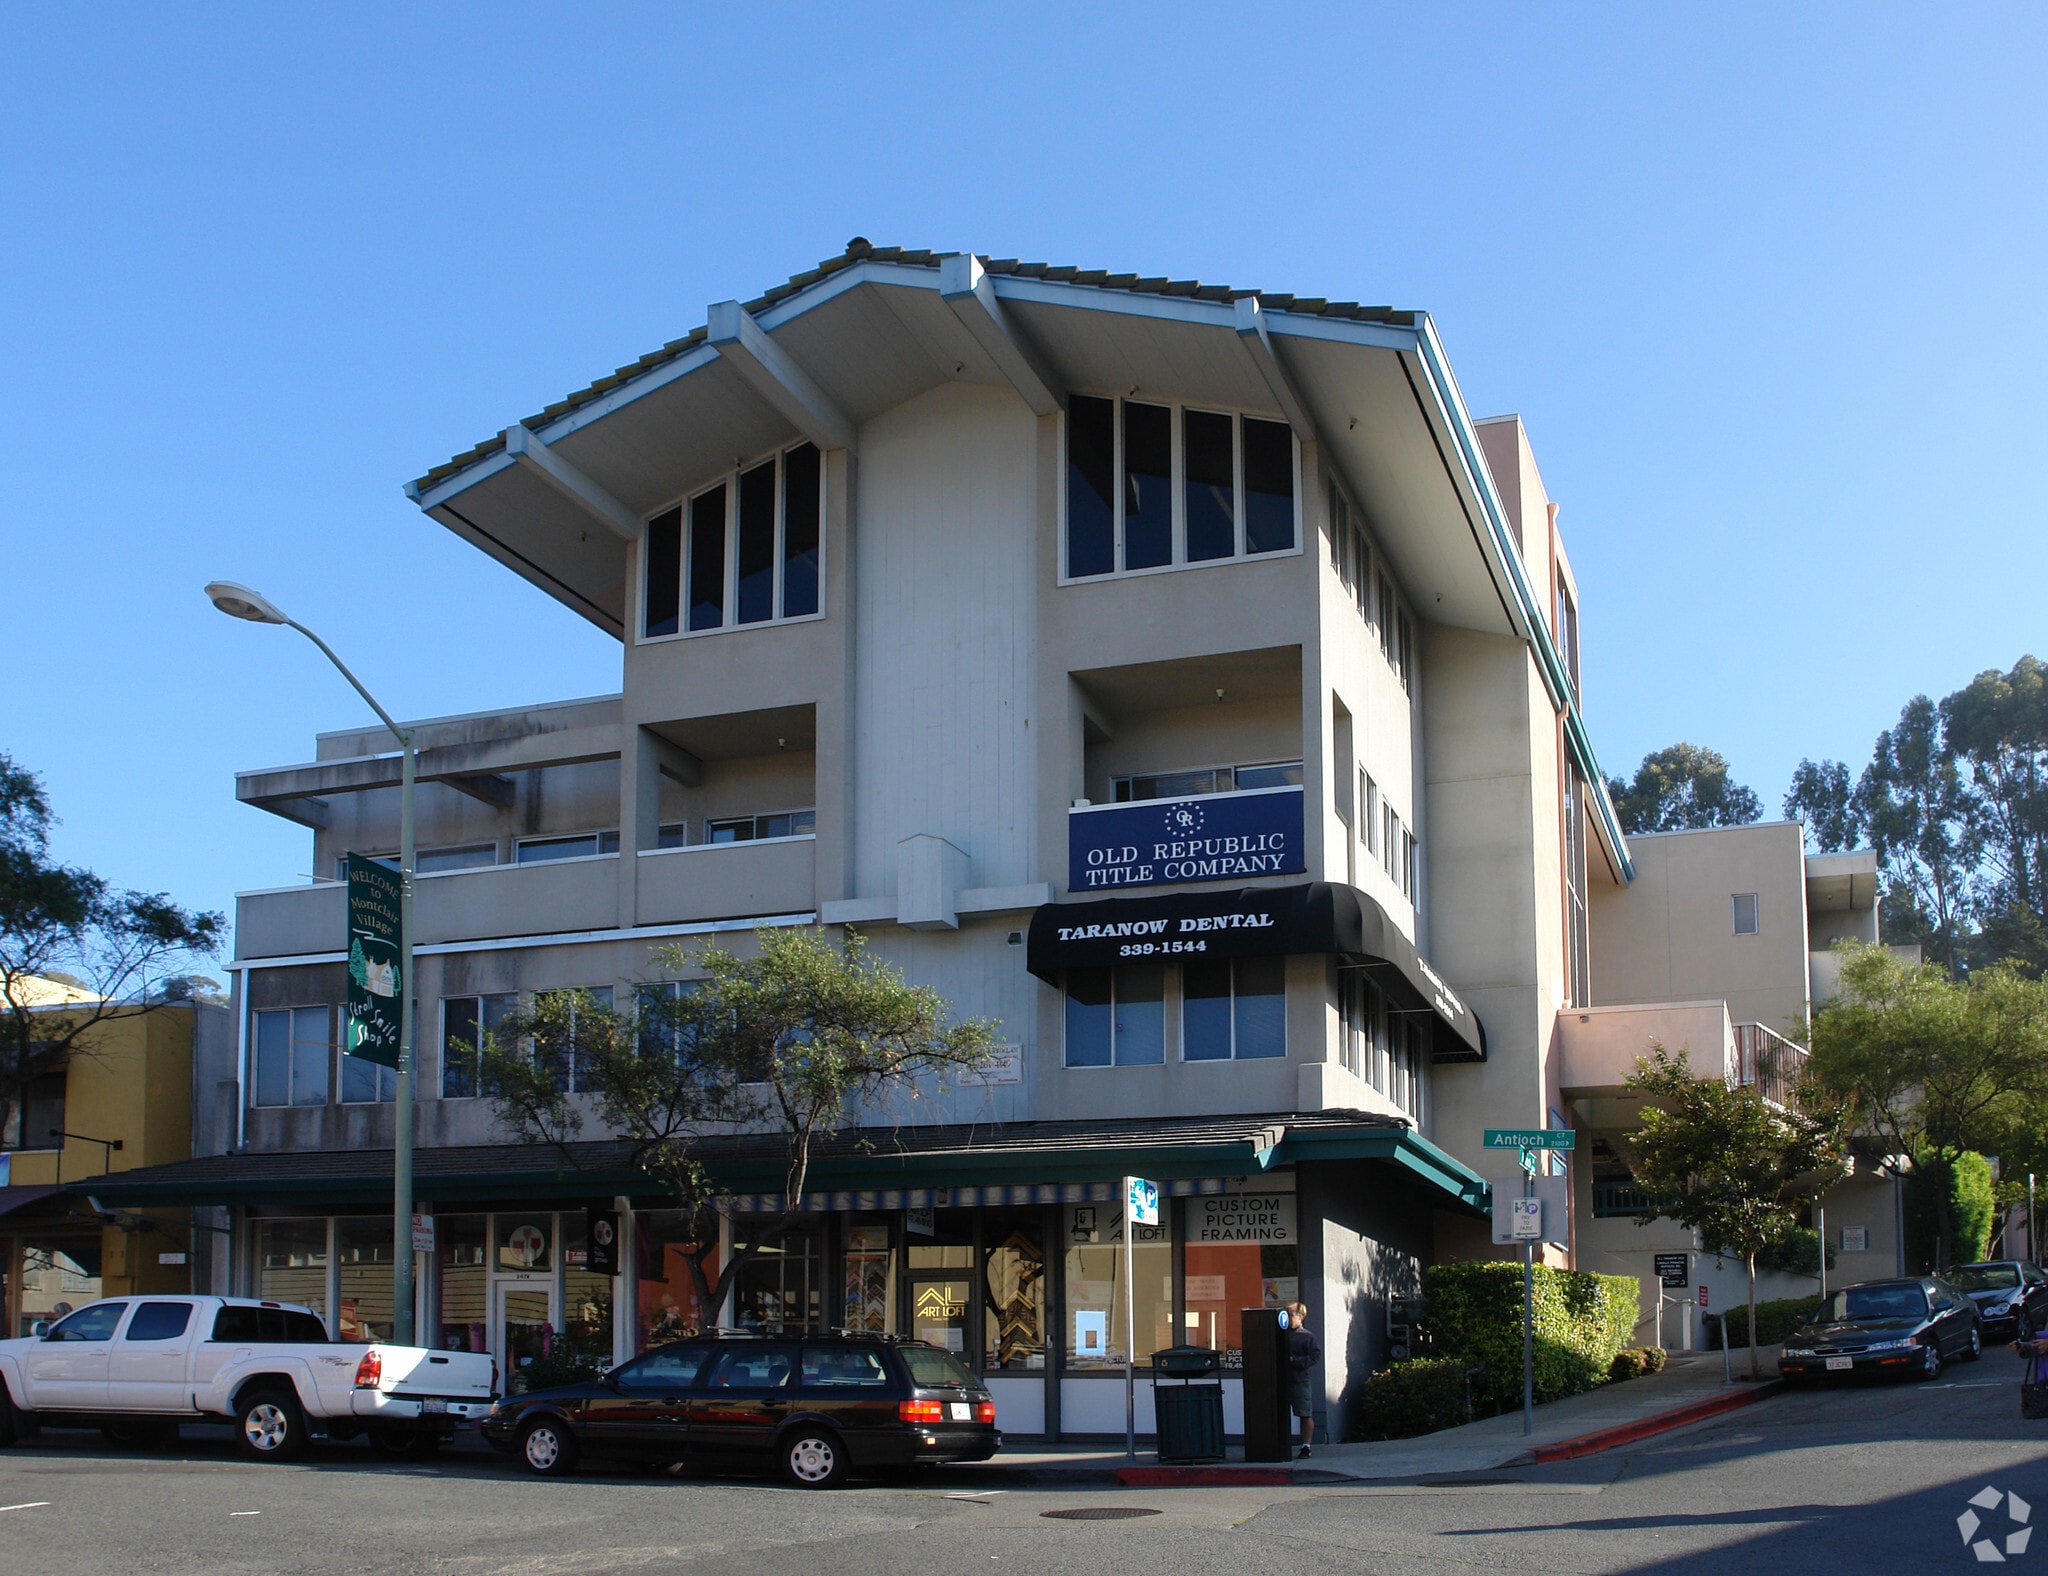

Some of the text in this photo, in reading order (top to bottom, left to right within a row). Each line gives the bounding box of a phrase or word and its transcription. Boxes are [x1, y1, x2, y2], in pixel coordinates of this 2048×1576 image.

[1087, 833, 1285, 866] OLD REPUBLIC
[1086, 853, 1286, 886] TITLE COMPANY
[350, 870, 400, 900] WELCOME
[370, 887, 382, 899] to
[350, 897, 400, 924] Montclair
[356, 913, 393, 935] Village
[1057, 913, 1275, 941] TARANOW DENTAL
[1119, 940, 1207, 957] 339-1544
[349, 994, 373, 1026] Stroll
[356, 1024, 382, 1047] Shop
[1494, 1134, 1544, 1146] Antioch
[1204, 1198, 1280, 1212] CUSTOM
[1206, 1213, 1278, 1226] PICTURE
[1140, 1228, 1166, 1240] LOFT
[1201, 1227, 1287, 1241] FRAMING
[917, 1306, 965, 1318] ART LOFT
